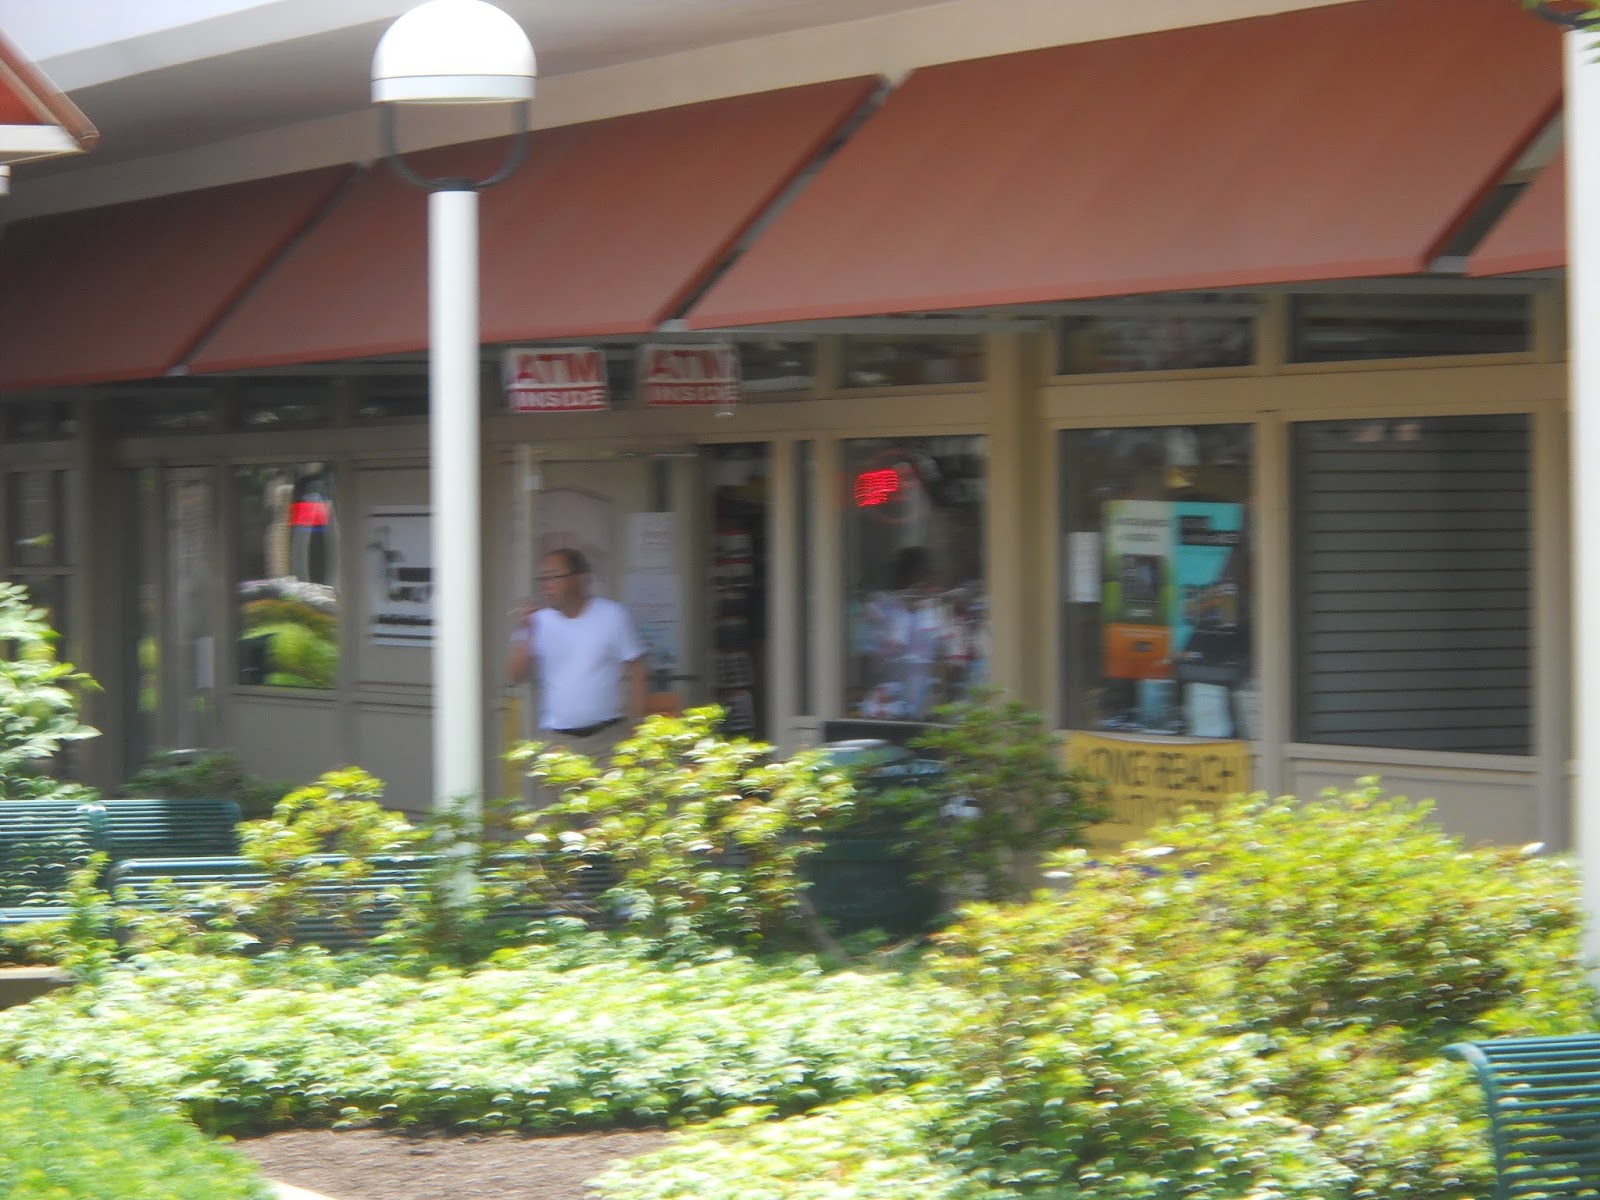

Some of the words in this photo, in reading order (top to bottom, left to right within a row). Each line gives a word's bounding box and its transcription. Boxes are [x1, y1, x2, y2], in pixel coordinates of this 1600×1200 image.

[516, 353, 602, 383] ATM
[652, 350, 735, 379] ATM
[513, 390, 605, 407] INSIDE
[648, 385, 736, 402] INSIDE
